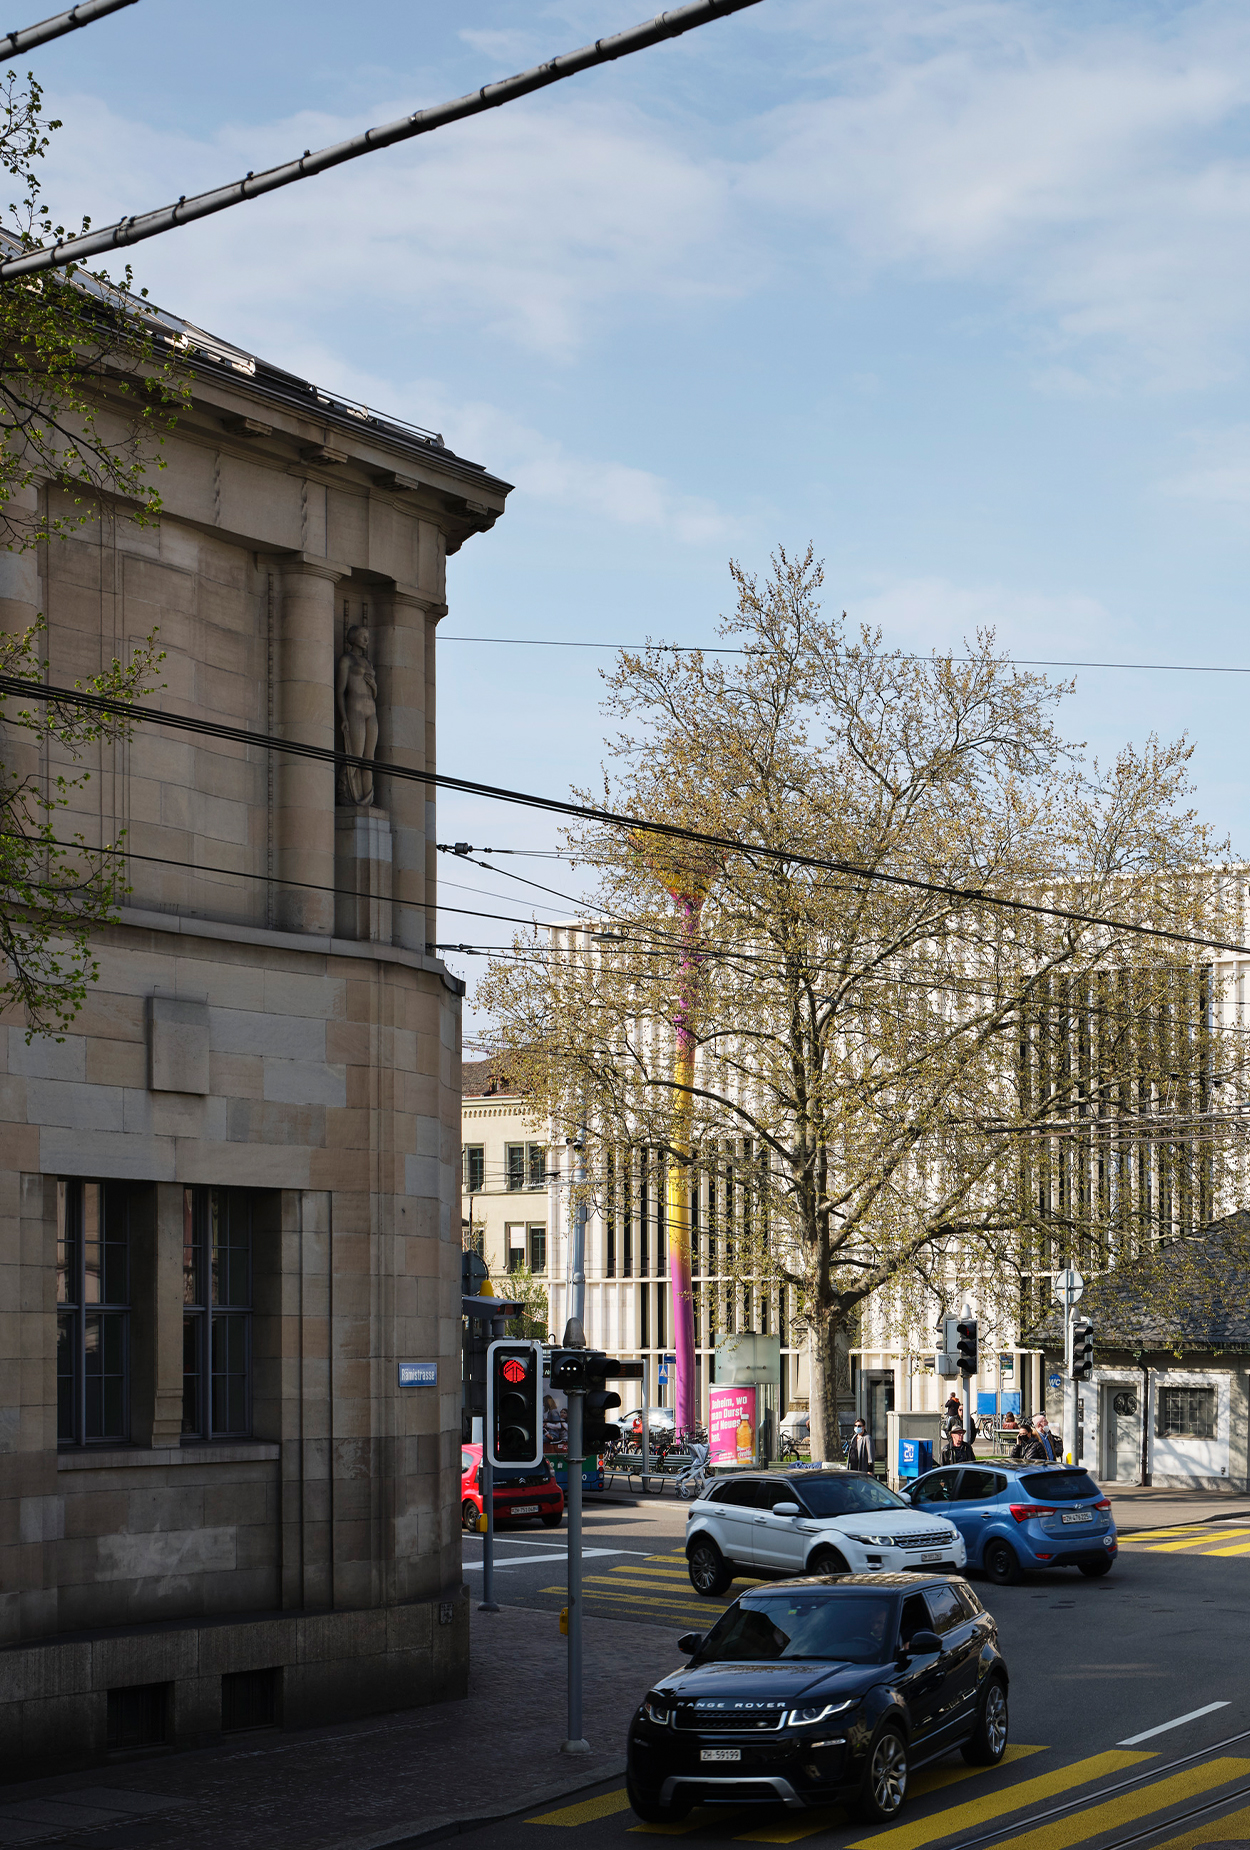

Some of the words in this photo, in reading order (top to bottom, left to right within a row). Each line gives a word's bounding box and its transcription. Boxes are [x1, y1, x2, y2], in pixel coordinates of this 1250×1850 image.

[402, 1368, 435, 1380] Rämistrasse
[1049, 1378, 1061, 1386] WC
[711, 1397, 734, 1410] Daheim,
[736, 1396, 747, 1405] wo
[711, 1411, 722, 1420] man
[723, 1407, 743, 1418] Durst
[711, 1421, 719, 1431] auf
[720, 1419, 741, 1430] Neues
